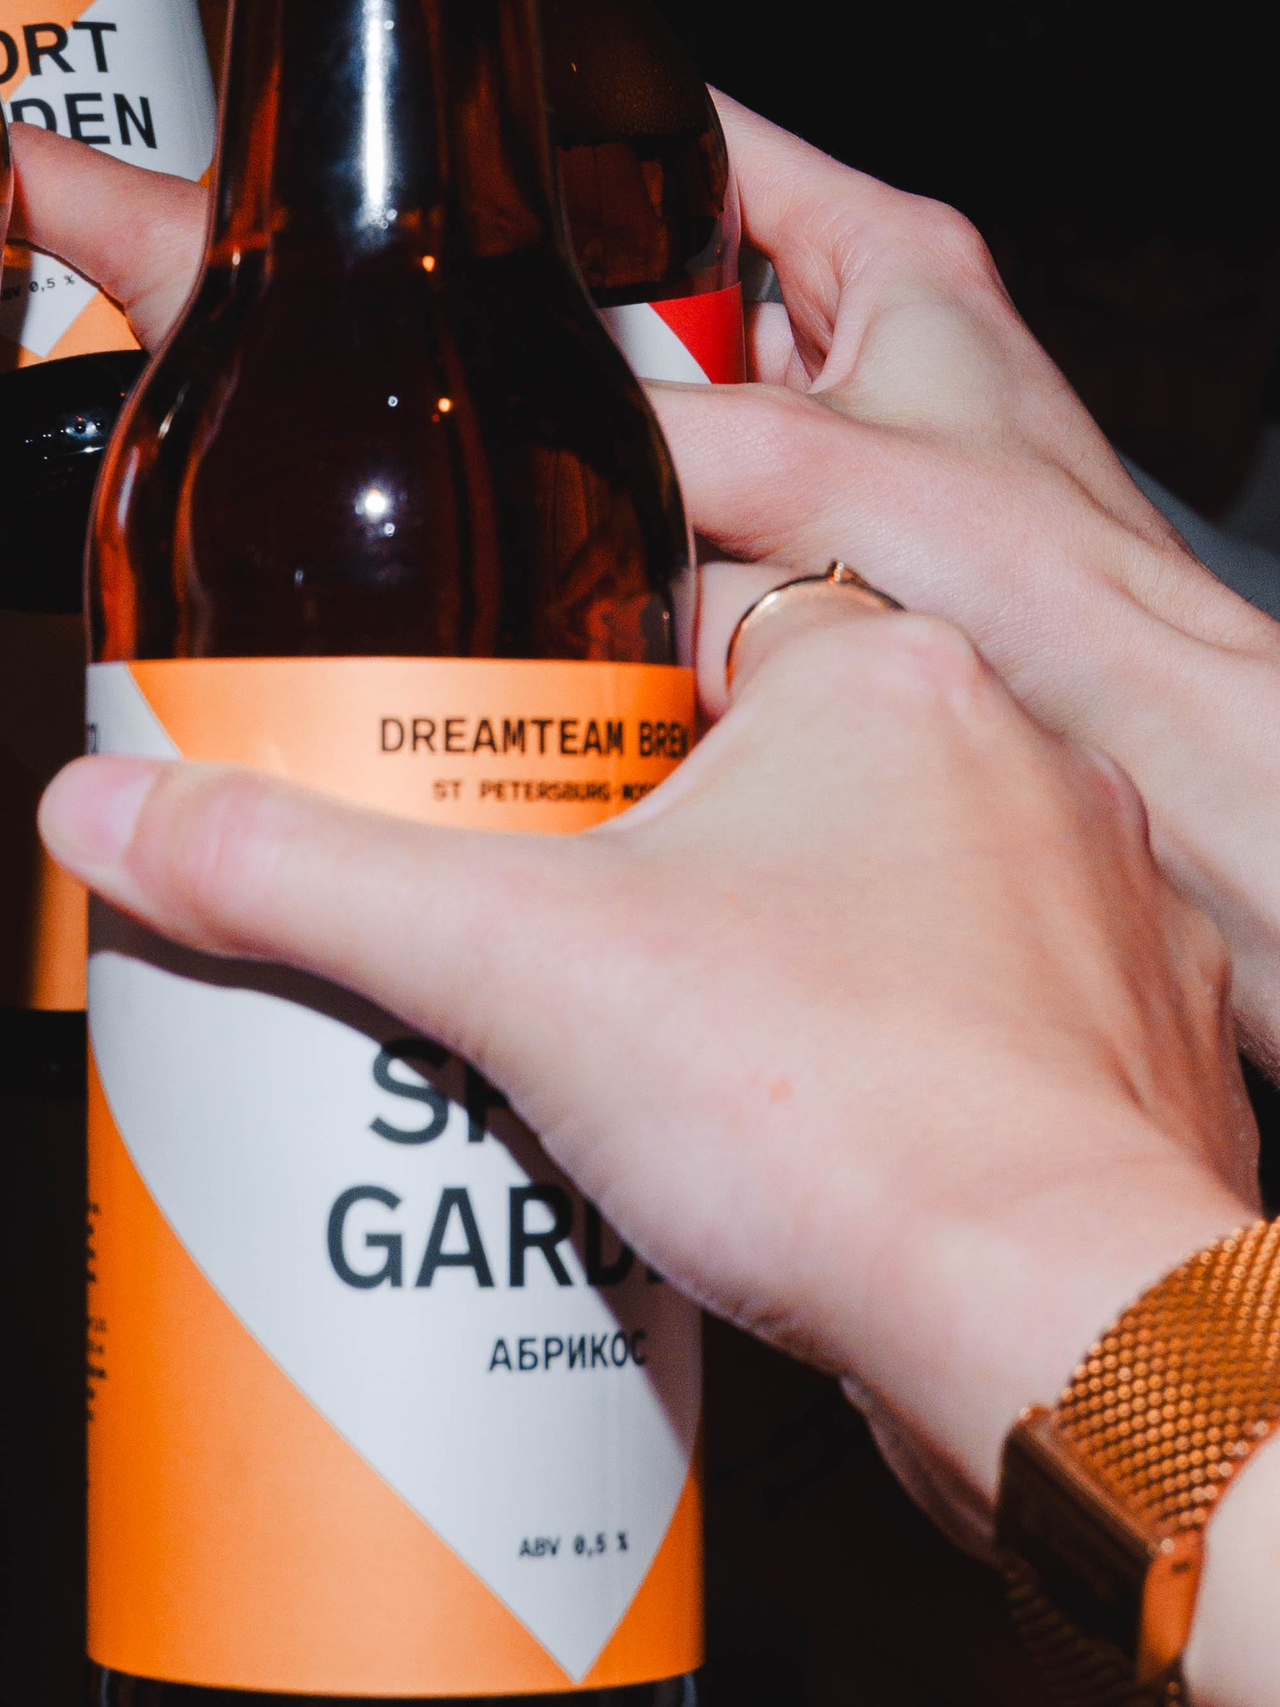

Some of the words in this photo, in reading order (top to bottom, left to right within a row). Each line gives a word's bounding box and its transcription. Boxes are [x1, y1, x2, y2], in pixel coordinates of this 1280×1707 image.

[30, 277, 55, 293] 0,5
[381, 718, 624, 756] DREAMTEAM
[433, 781, 462, 801] ST
[327, 1185, 662, 1290] GARD
[489, 1329, 647, 1372] АБРИКОС
[519, 1537, 561, 1557] ABV
[574, 1532, 606, 1557] 0,5
[617, 1531, 629, 1551] %
